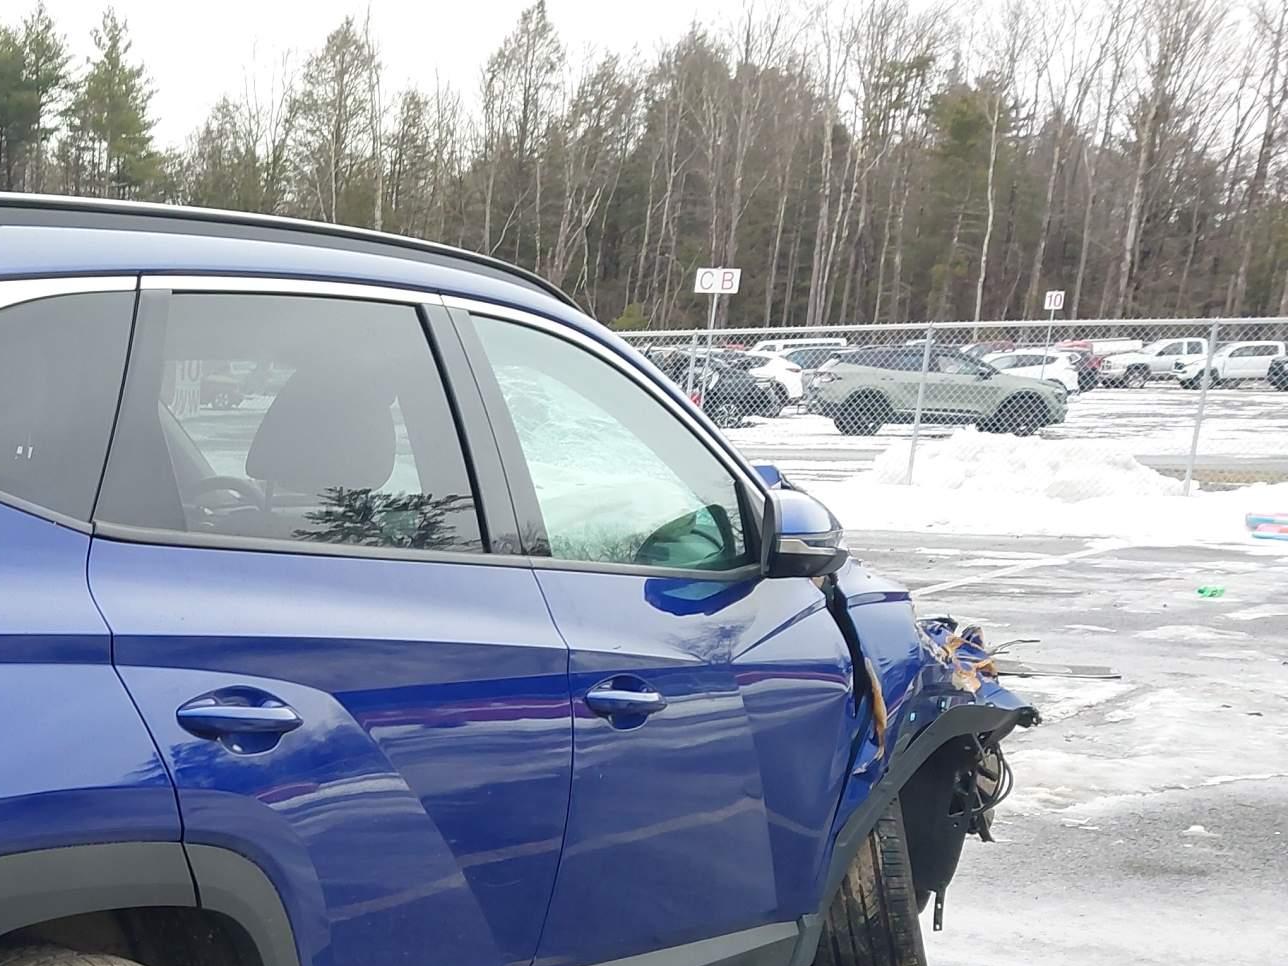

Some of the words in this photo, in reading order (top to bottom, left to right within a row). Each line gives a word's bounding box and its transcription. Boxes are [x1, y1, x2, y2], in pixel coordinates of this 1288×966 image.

[700, 271, 714, 290] C
[721, 271, 734, 290] B
[1047, 294, 1062, 308] 10
